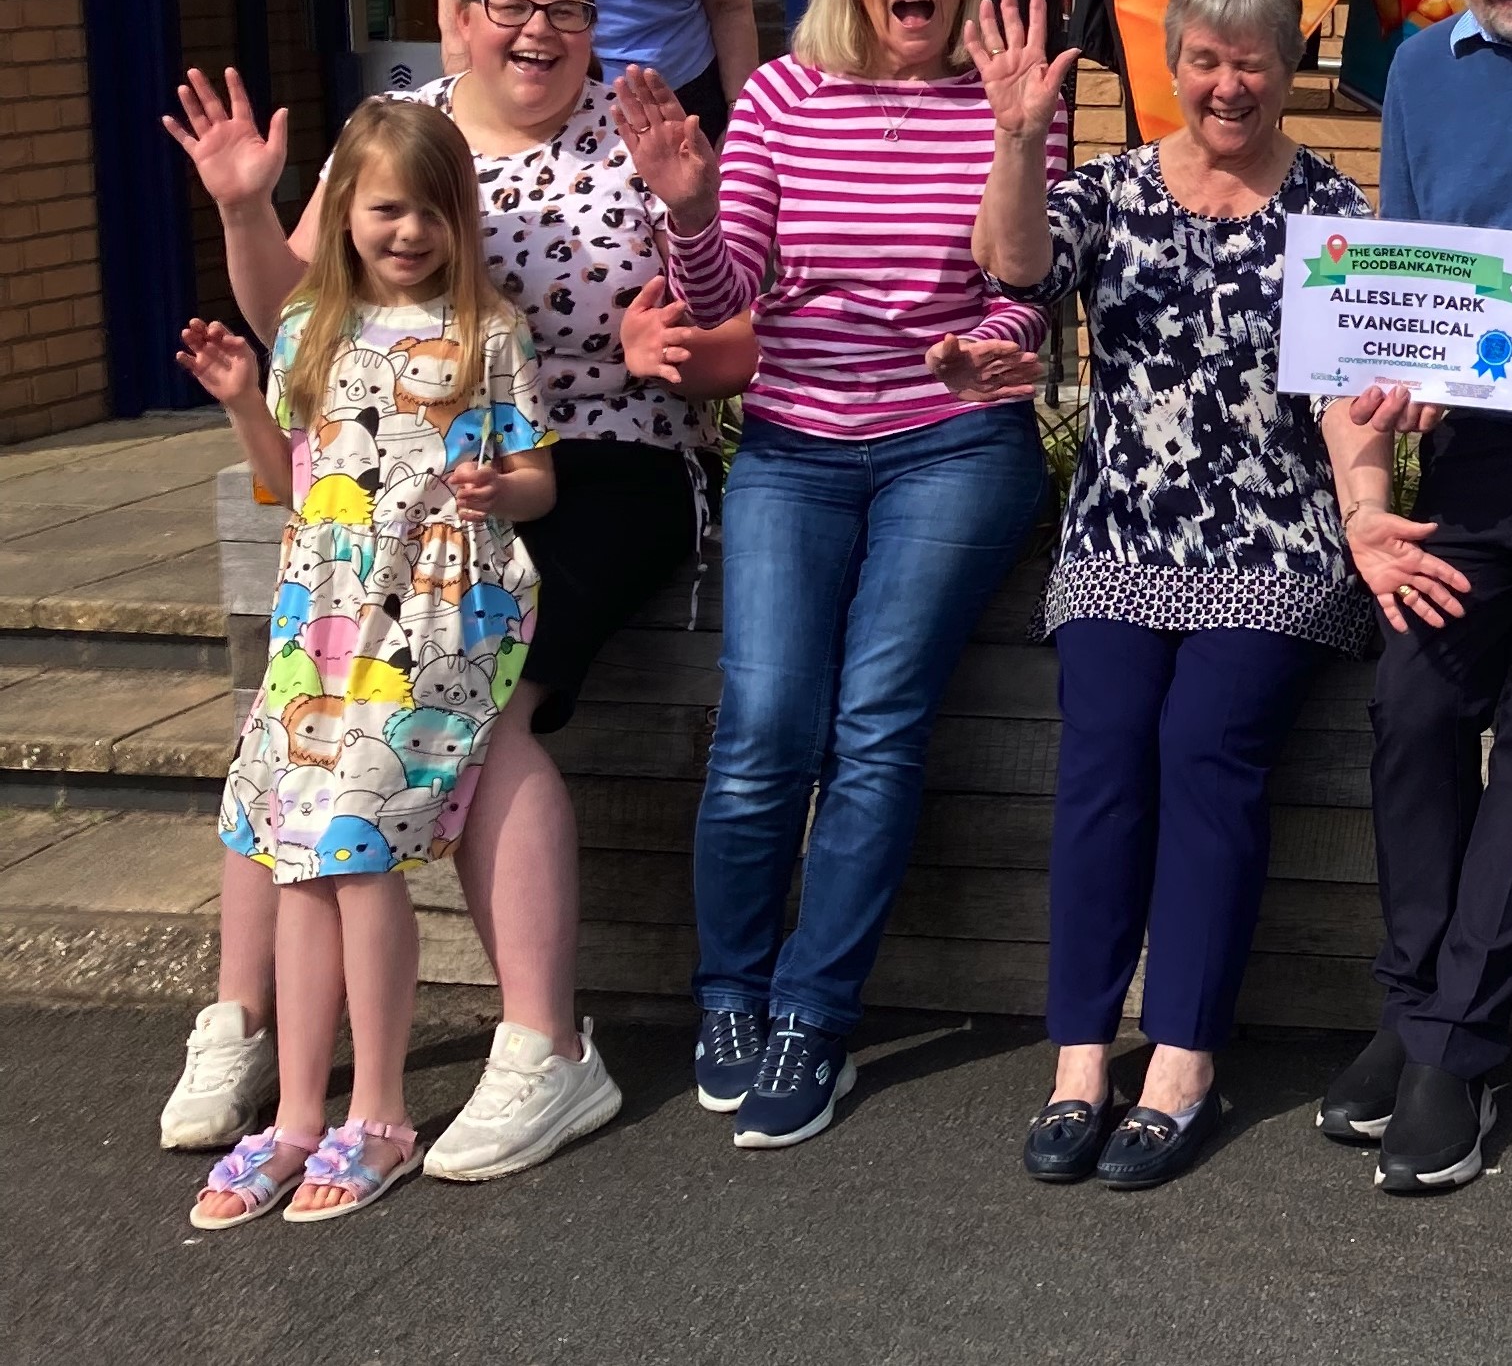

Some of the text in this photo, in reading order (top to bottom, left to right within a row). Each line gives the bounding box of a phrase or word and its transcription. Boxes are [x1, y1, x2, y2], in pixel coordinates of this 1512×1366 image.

[1348, 247, 1477, 266] THE GREAT COVENTRY
[1352, 260, 1472, 279] FOODBANKATHON
[1330, 287, 1485, 313] ALLESLEY PARK
[1338, 313, 1474, 338] EVANGELICAL
[1363, 341, 1447, 361] CHURCH
